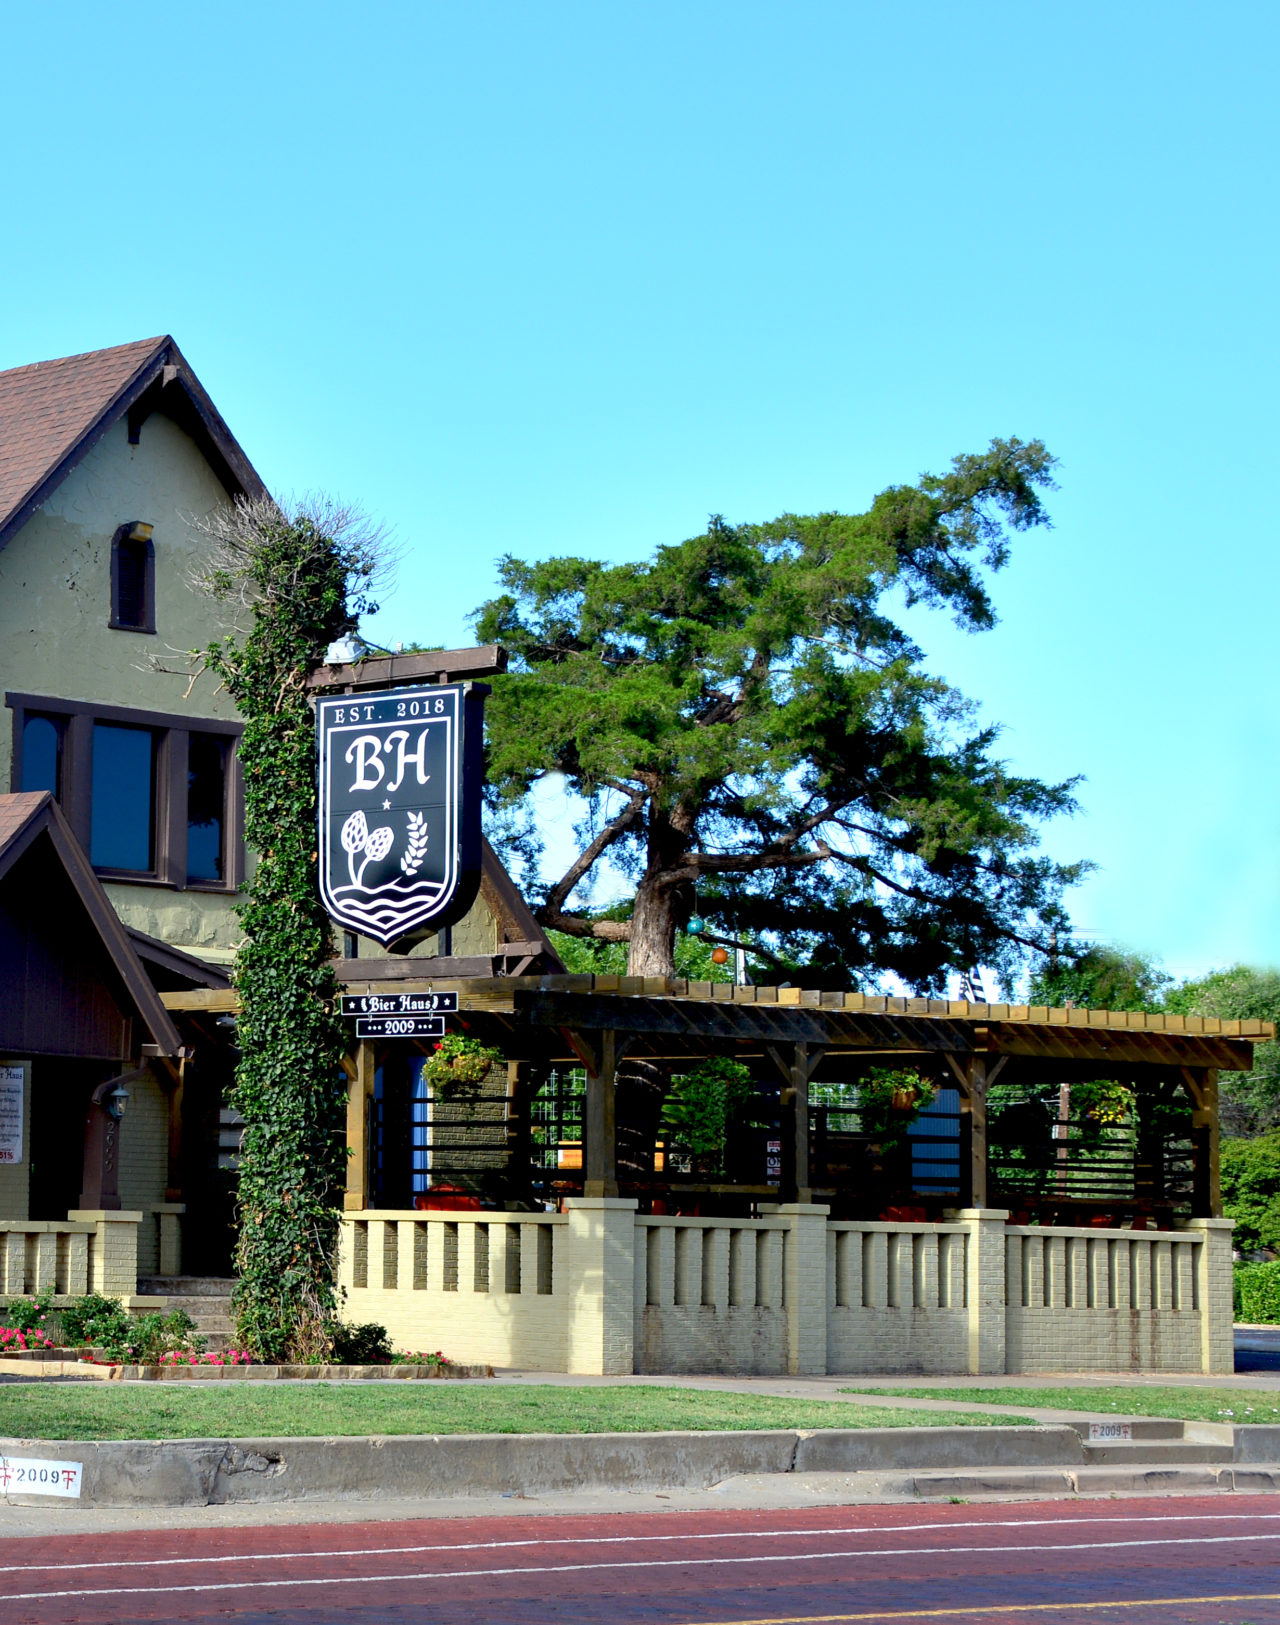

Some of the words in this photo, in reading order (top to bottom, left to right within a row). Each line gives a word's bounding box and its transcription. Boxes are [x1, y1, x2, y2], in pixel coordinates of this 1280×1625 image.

[334, 705, 382, 724] EST.
[397, 699, 445, 717] 2018
[345, 728, 431, 793] BH
[369, 996, 396, 1012] Bier
[399, 995, 431, 1011] Haus
[384, 1020, 415, 1034] 2009
[1099, 1425, 1122, 1437] 2009
[16, 1467, 60, 1484] 2009
